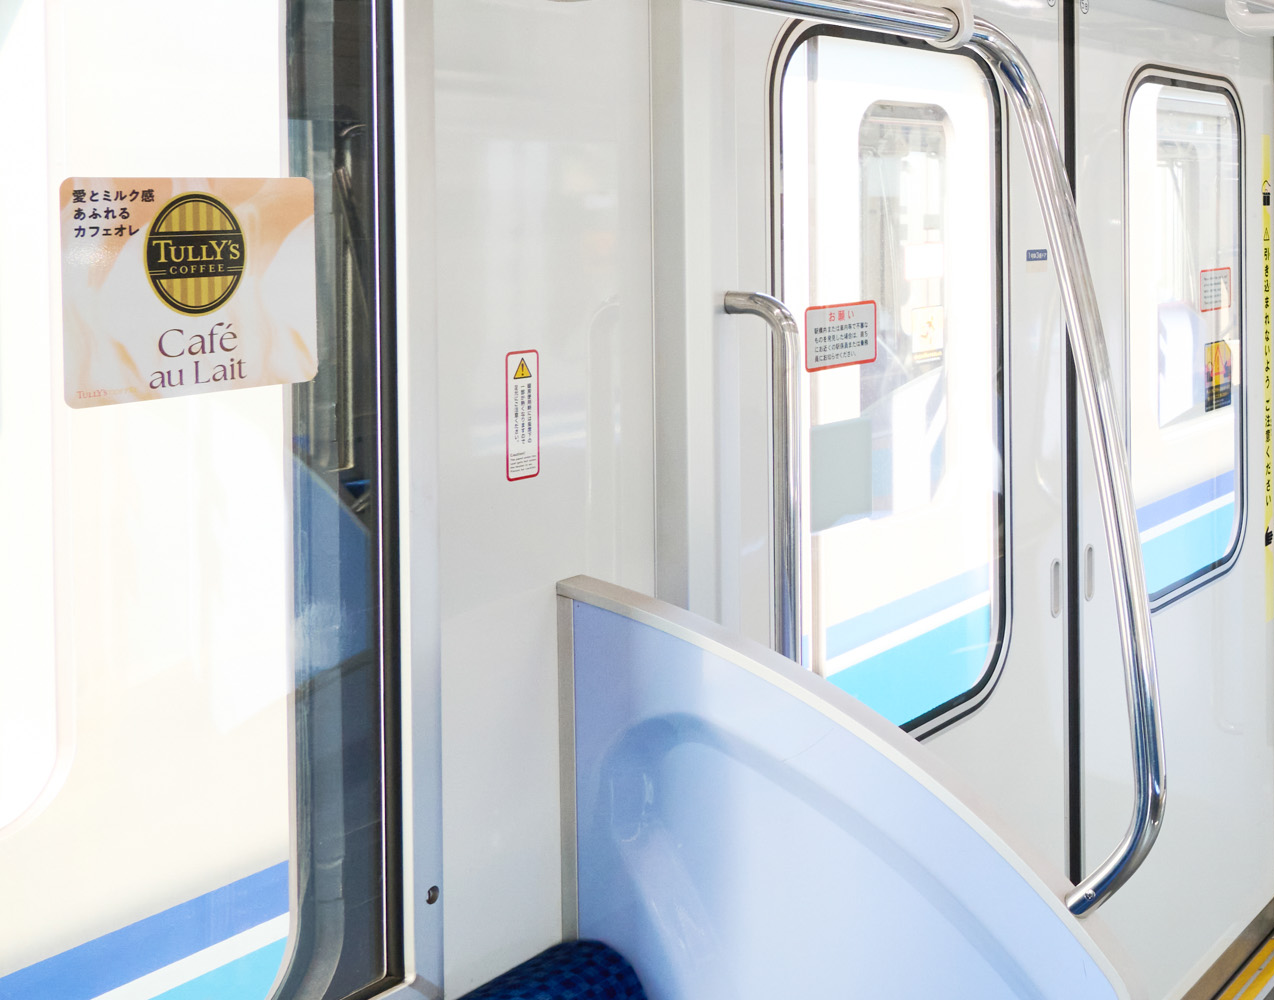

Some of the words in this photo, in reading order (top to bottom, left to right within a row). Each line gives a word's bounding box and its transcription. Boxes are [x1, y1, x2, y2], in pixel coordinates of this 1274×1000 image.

[72, 188, 154, 204] 愛とミルク感
[73, 207, 130, 221] あふれる
[73, 225, 140, 238] カフェオレ
[152, 240, 240, 263] TULLY'S
[169, 263, 225, 276] COFFEE
[829, 310, 854, 322] お願い
[158, 322, 238, 358] Café
[150, 368, 187, 389] au
[193, 358, 247, 385] Lait
